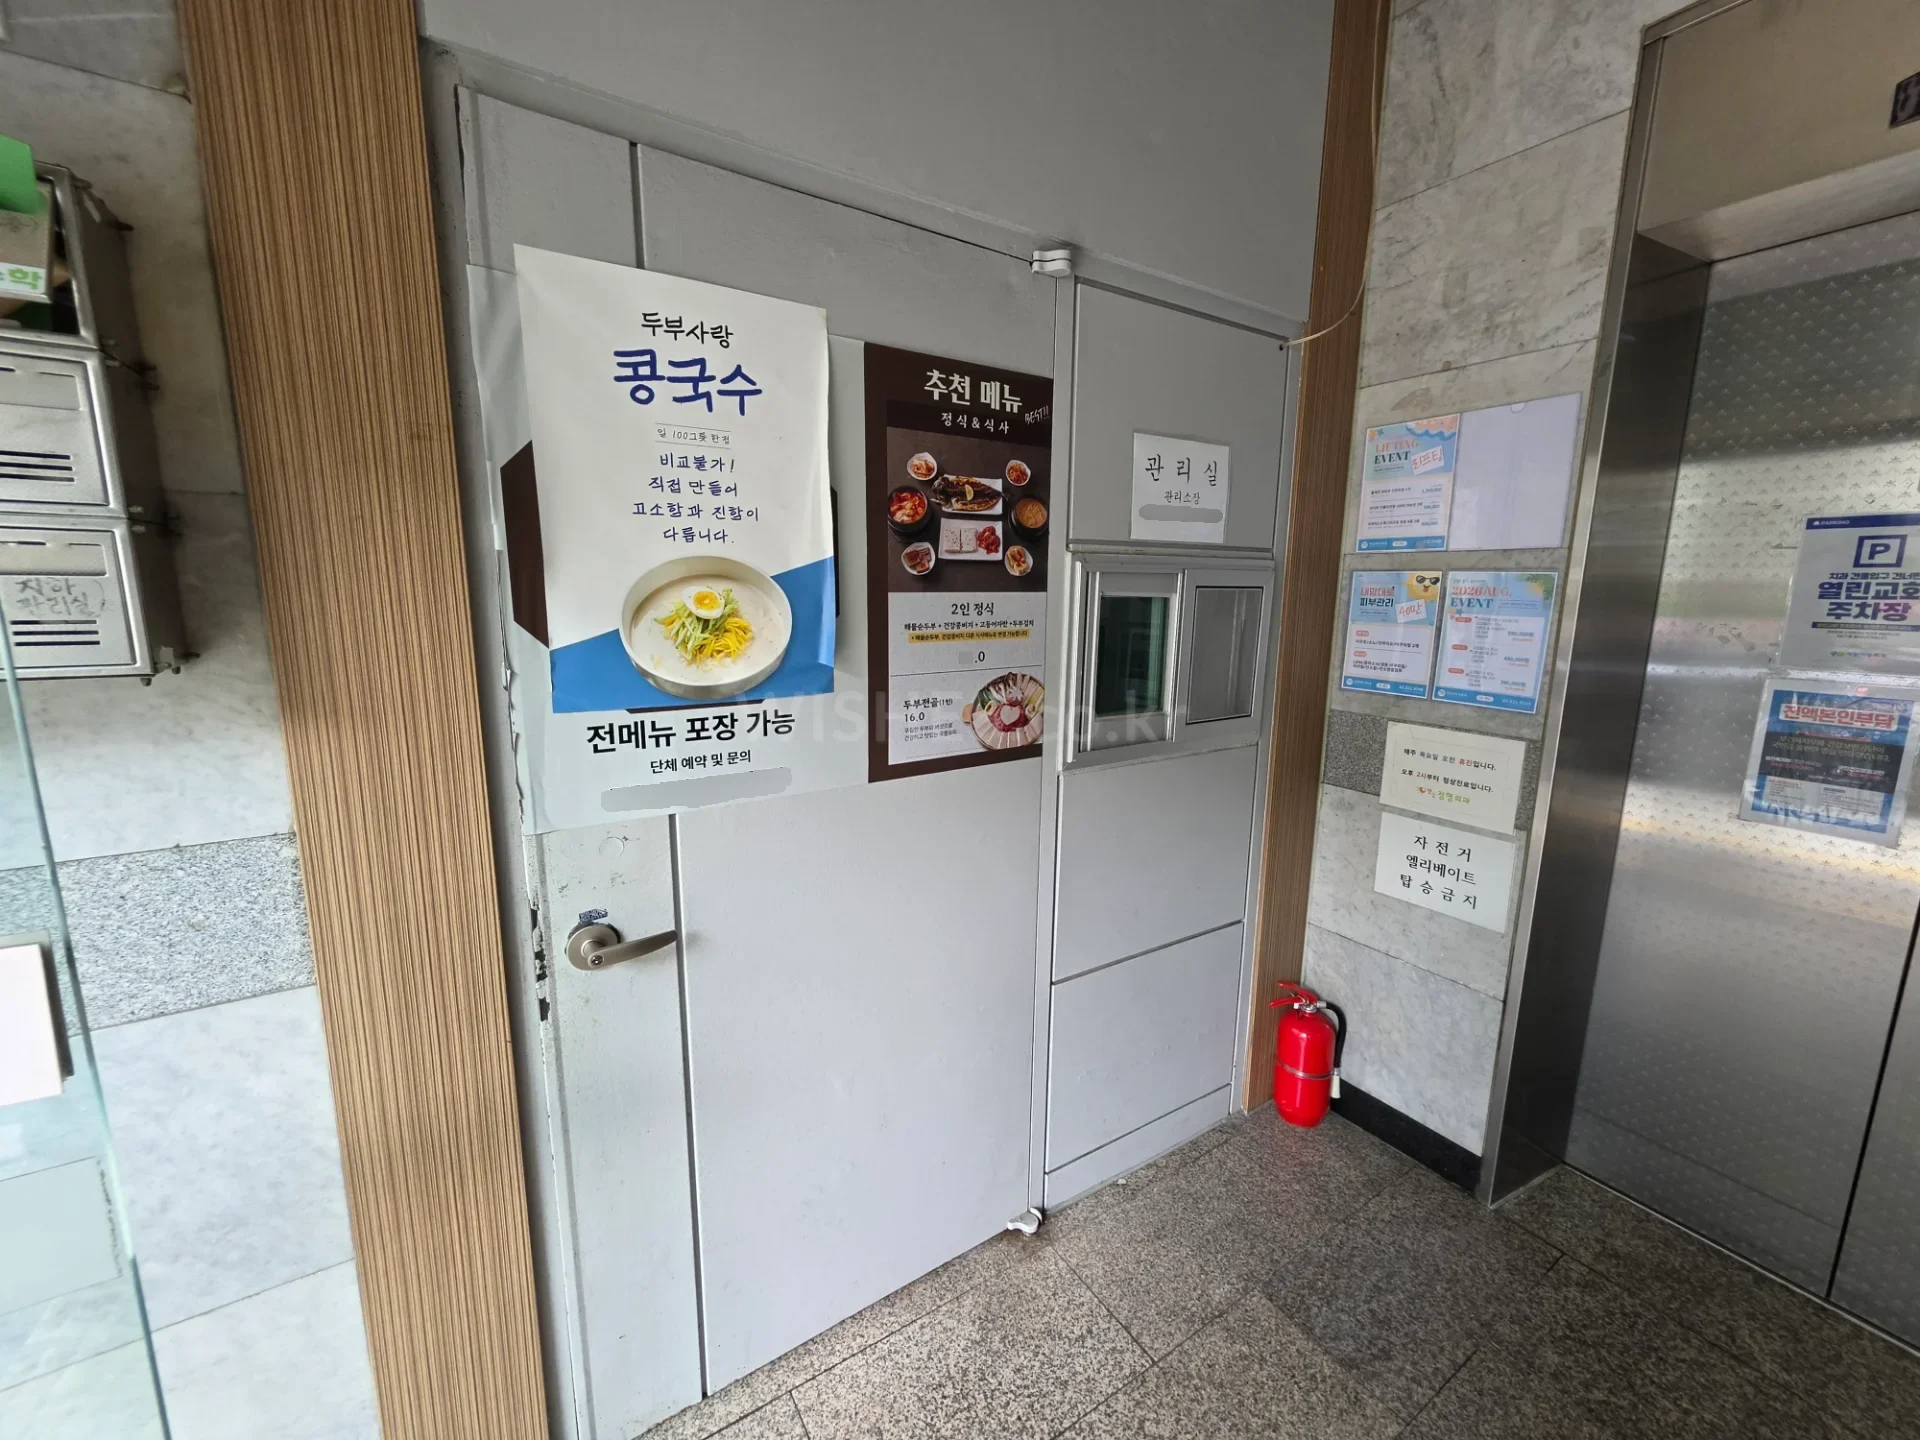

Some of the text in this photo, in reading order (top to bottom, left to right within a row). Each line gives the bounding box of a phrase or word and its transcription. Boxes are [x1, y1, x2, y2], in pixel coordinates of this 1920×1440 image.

[641, 312, 734, 348] 두부사랑
[613, 348, 763, 416] 콩국수
[923, 368, 1023, 412] 추천 메뉴
[1373, 450, 1412, 465] EVENT
[648, 475, 739, 498] 직접 만들어
[1164, 489, 1201, 506] 관리소장
[631, 501, 760, 523] 고소함과 진함이
[951, 602, 995, 617] 2인 정식
[1359, 597, 1394, 608] 피부관리
[1449, 597, 1494, 609] EVENT
[1826, 601, 1912, 622] 주차장
[904, 711, 926, 723] 16.0
[586, 709, 796, 755] 전메뉴 포장 가능
[650, 749, 752, 775] 단체 예약 및 문의
[1403, 748, 1417, 758] 매주
[1400, 767, 1414, 777] 오후
[1405, 853, 1477, 886] 엘리베이트
